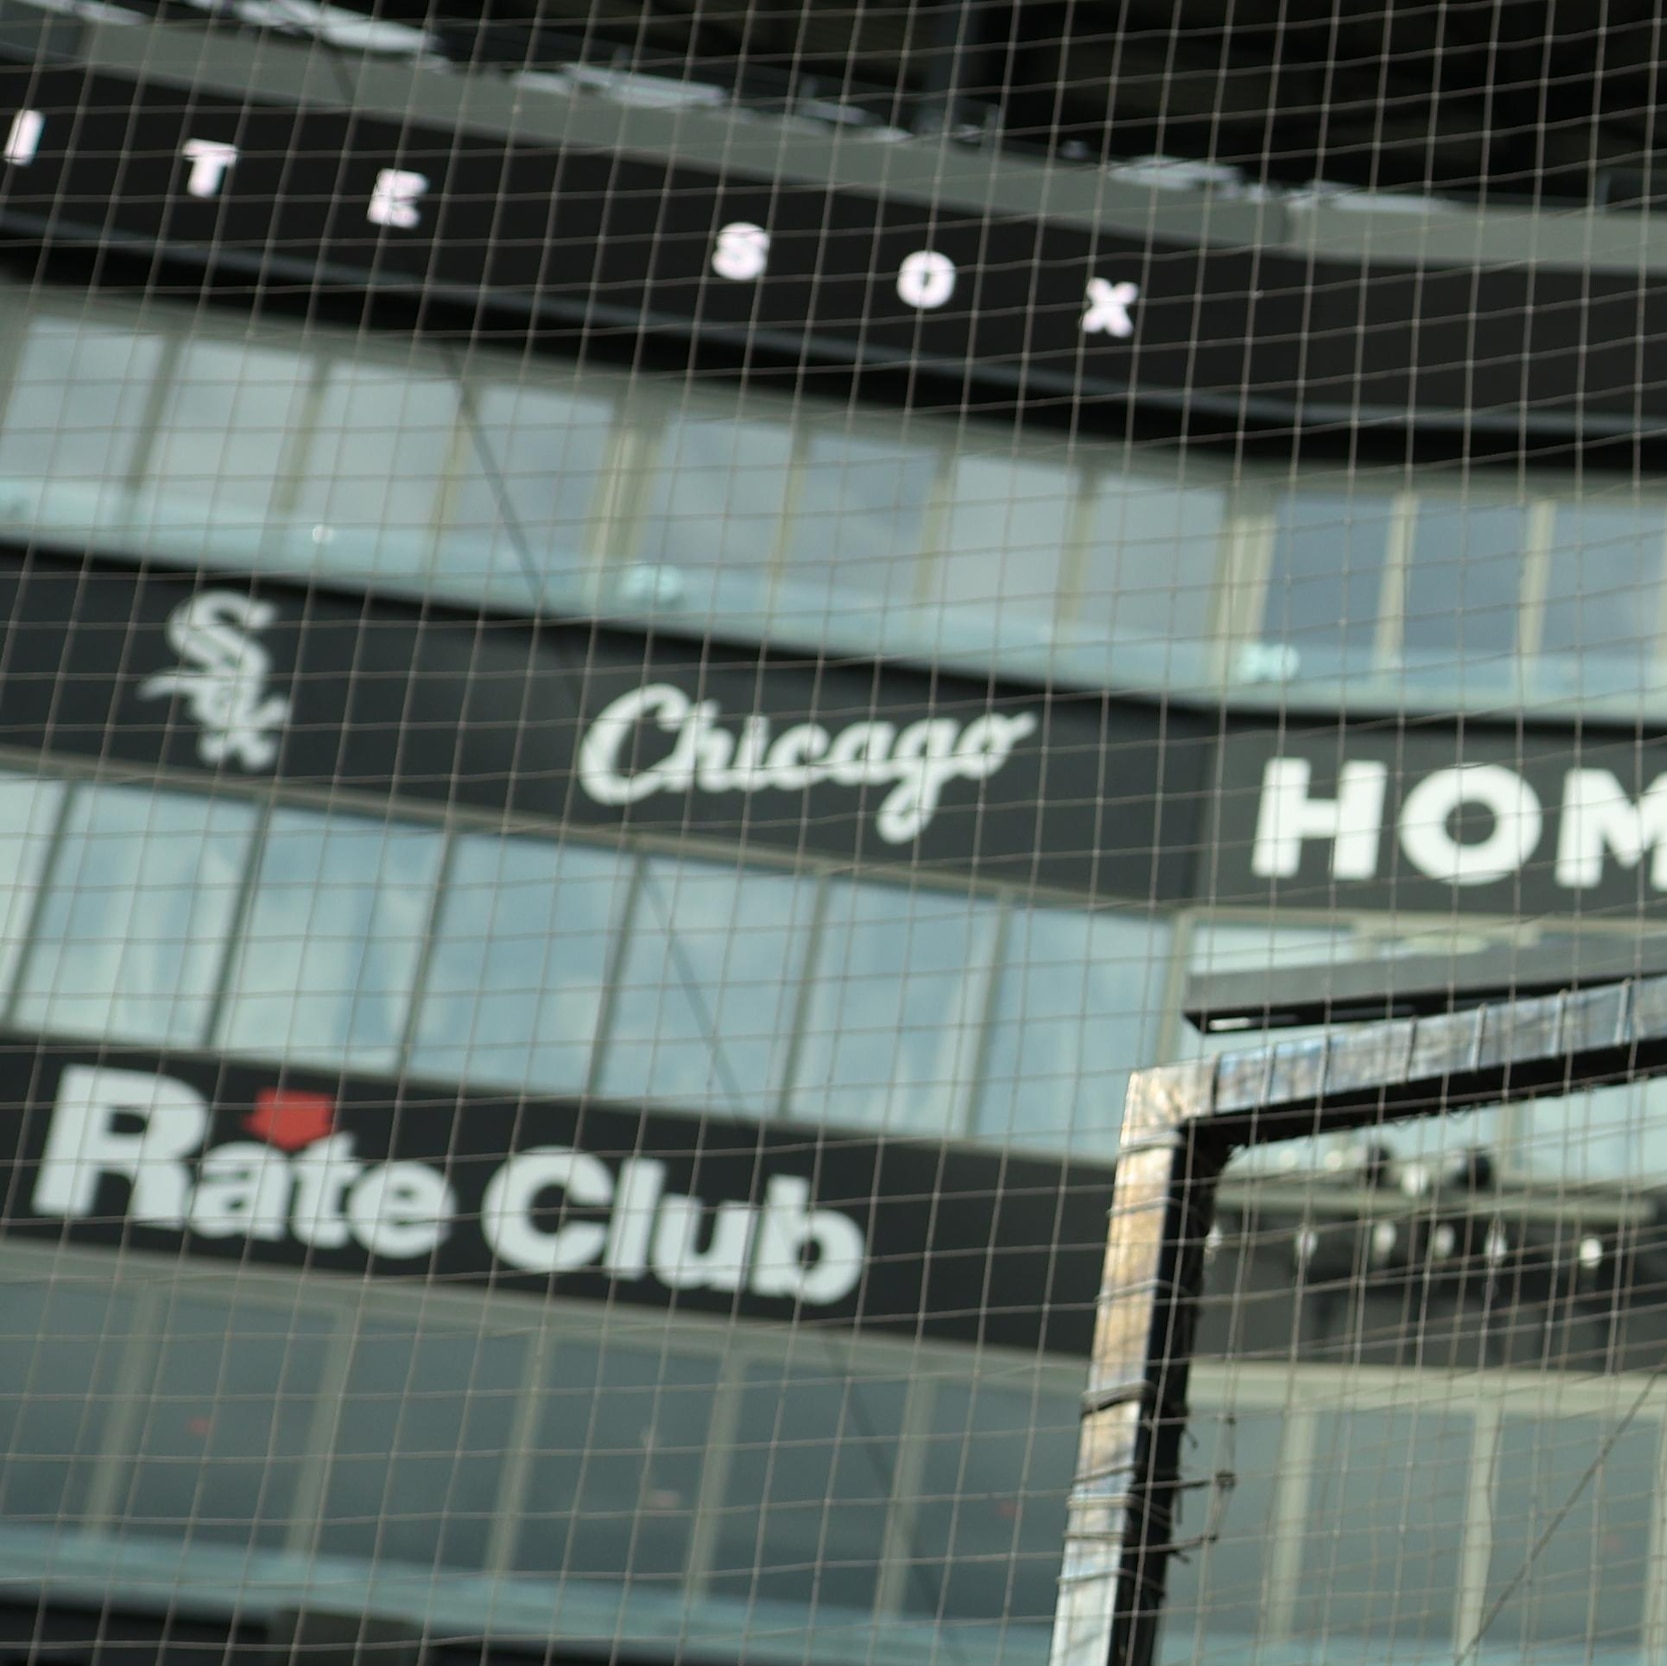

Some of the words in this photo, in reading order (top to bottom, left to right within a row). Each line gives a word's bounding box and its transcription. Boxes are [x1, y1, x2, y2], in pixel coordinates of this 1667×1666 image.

[711, 220, 1140, 338] SOX
[578, 684, 1036, 843] Chicago
[34, 1062, 456, 1260] Rate
[482, 1145, 867, 1307] Club
